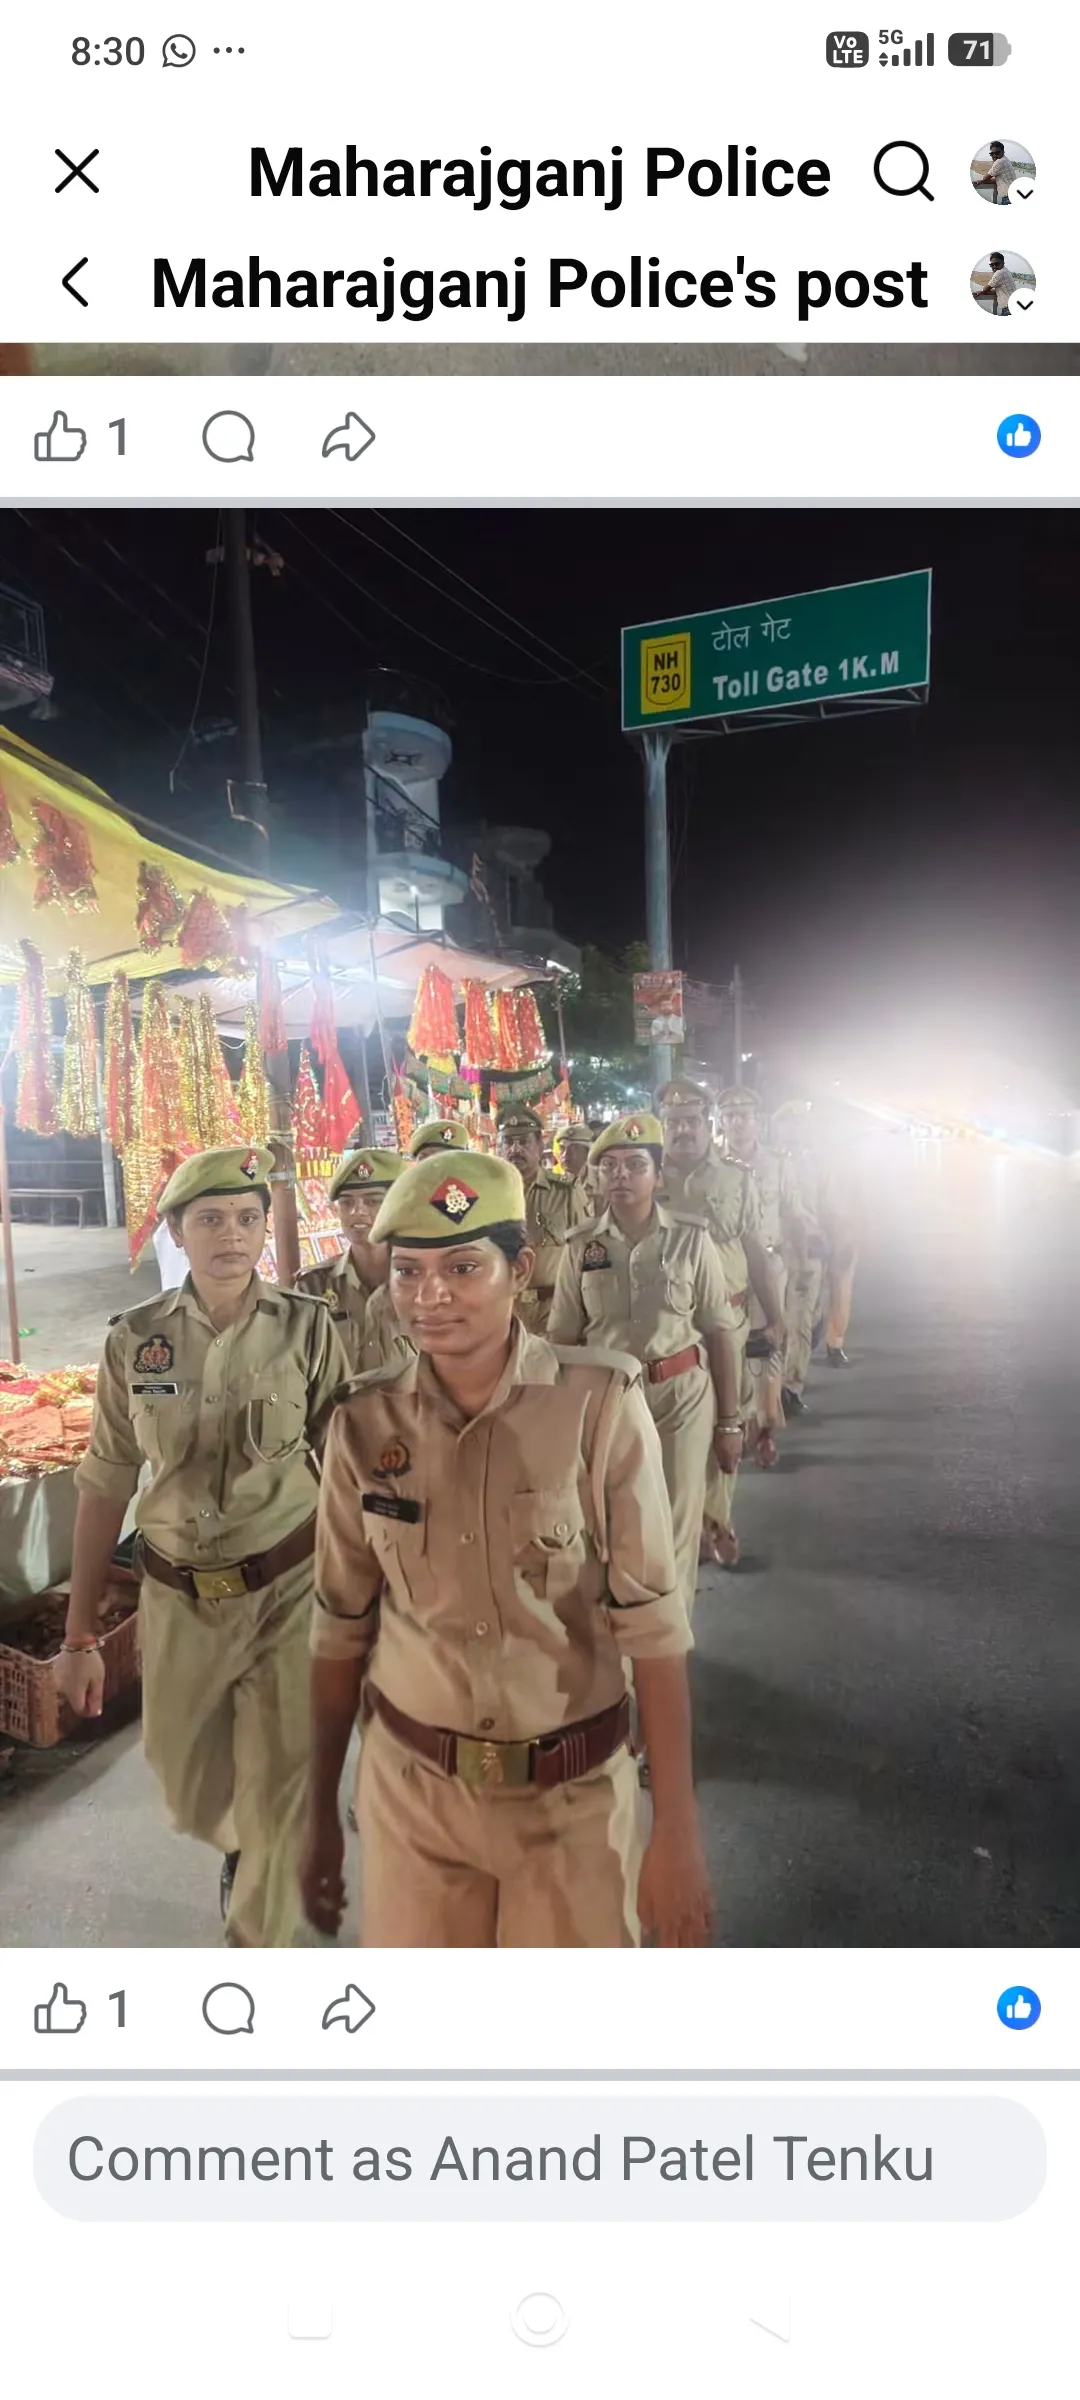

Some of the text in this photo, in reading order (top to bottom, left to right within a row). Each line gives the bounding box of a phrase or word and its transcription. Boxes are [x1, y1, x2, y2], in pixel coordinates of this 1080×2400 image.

[711, 612, 792, 651] टोल गेट
[653, 650, 679, 671] NH
[651, 673, 681, 695] 730
[712, 670, 759, 700] Toll
[766, 662, 829, 692] Gate
